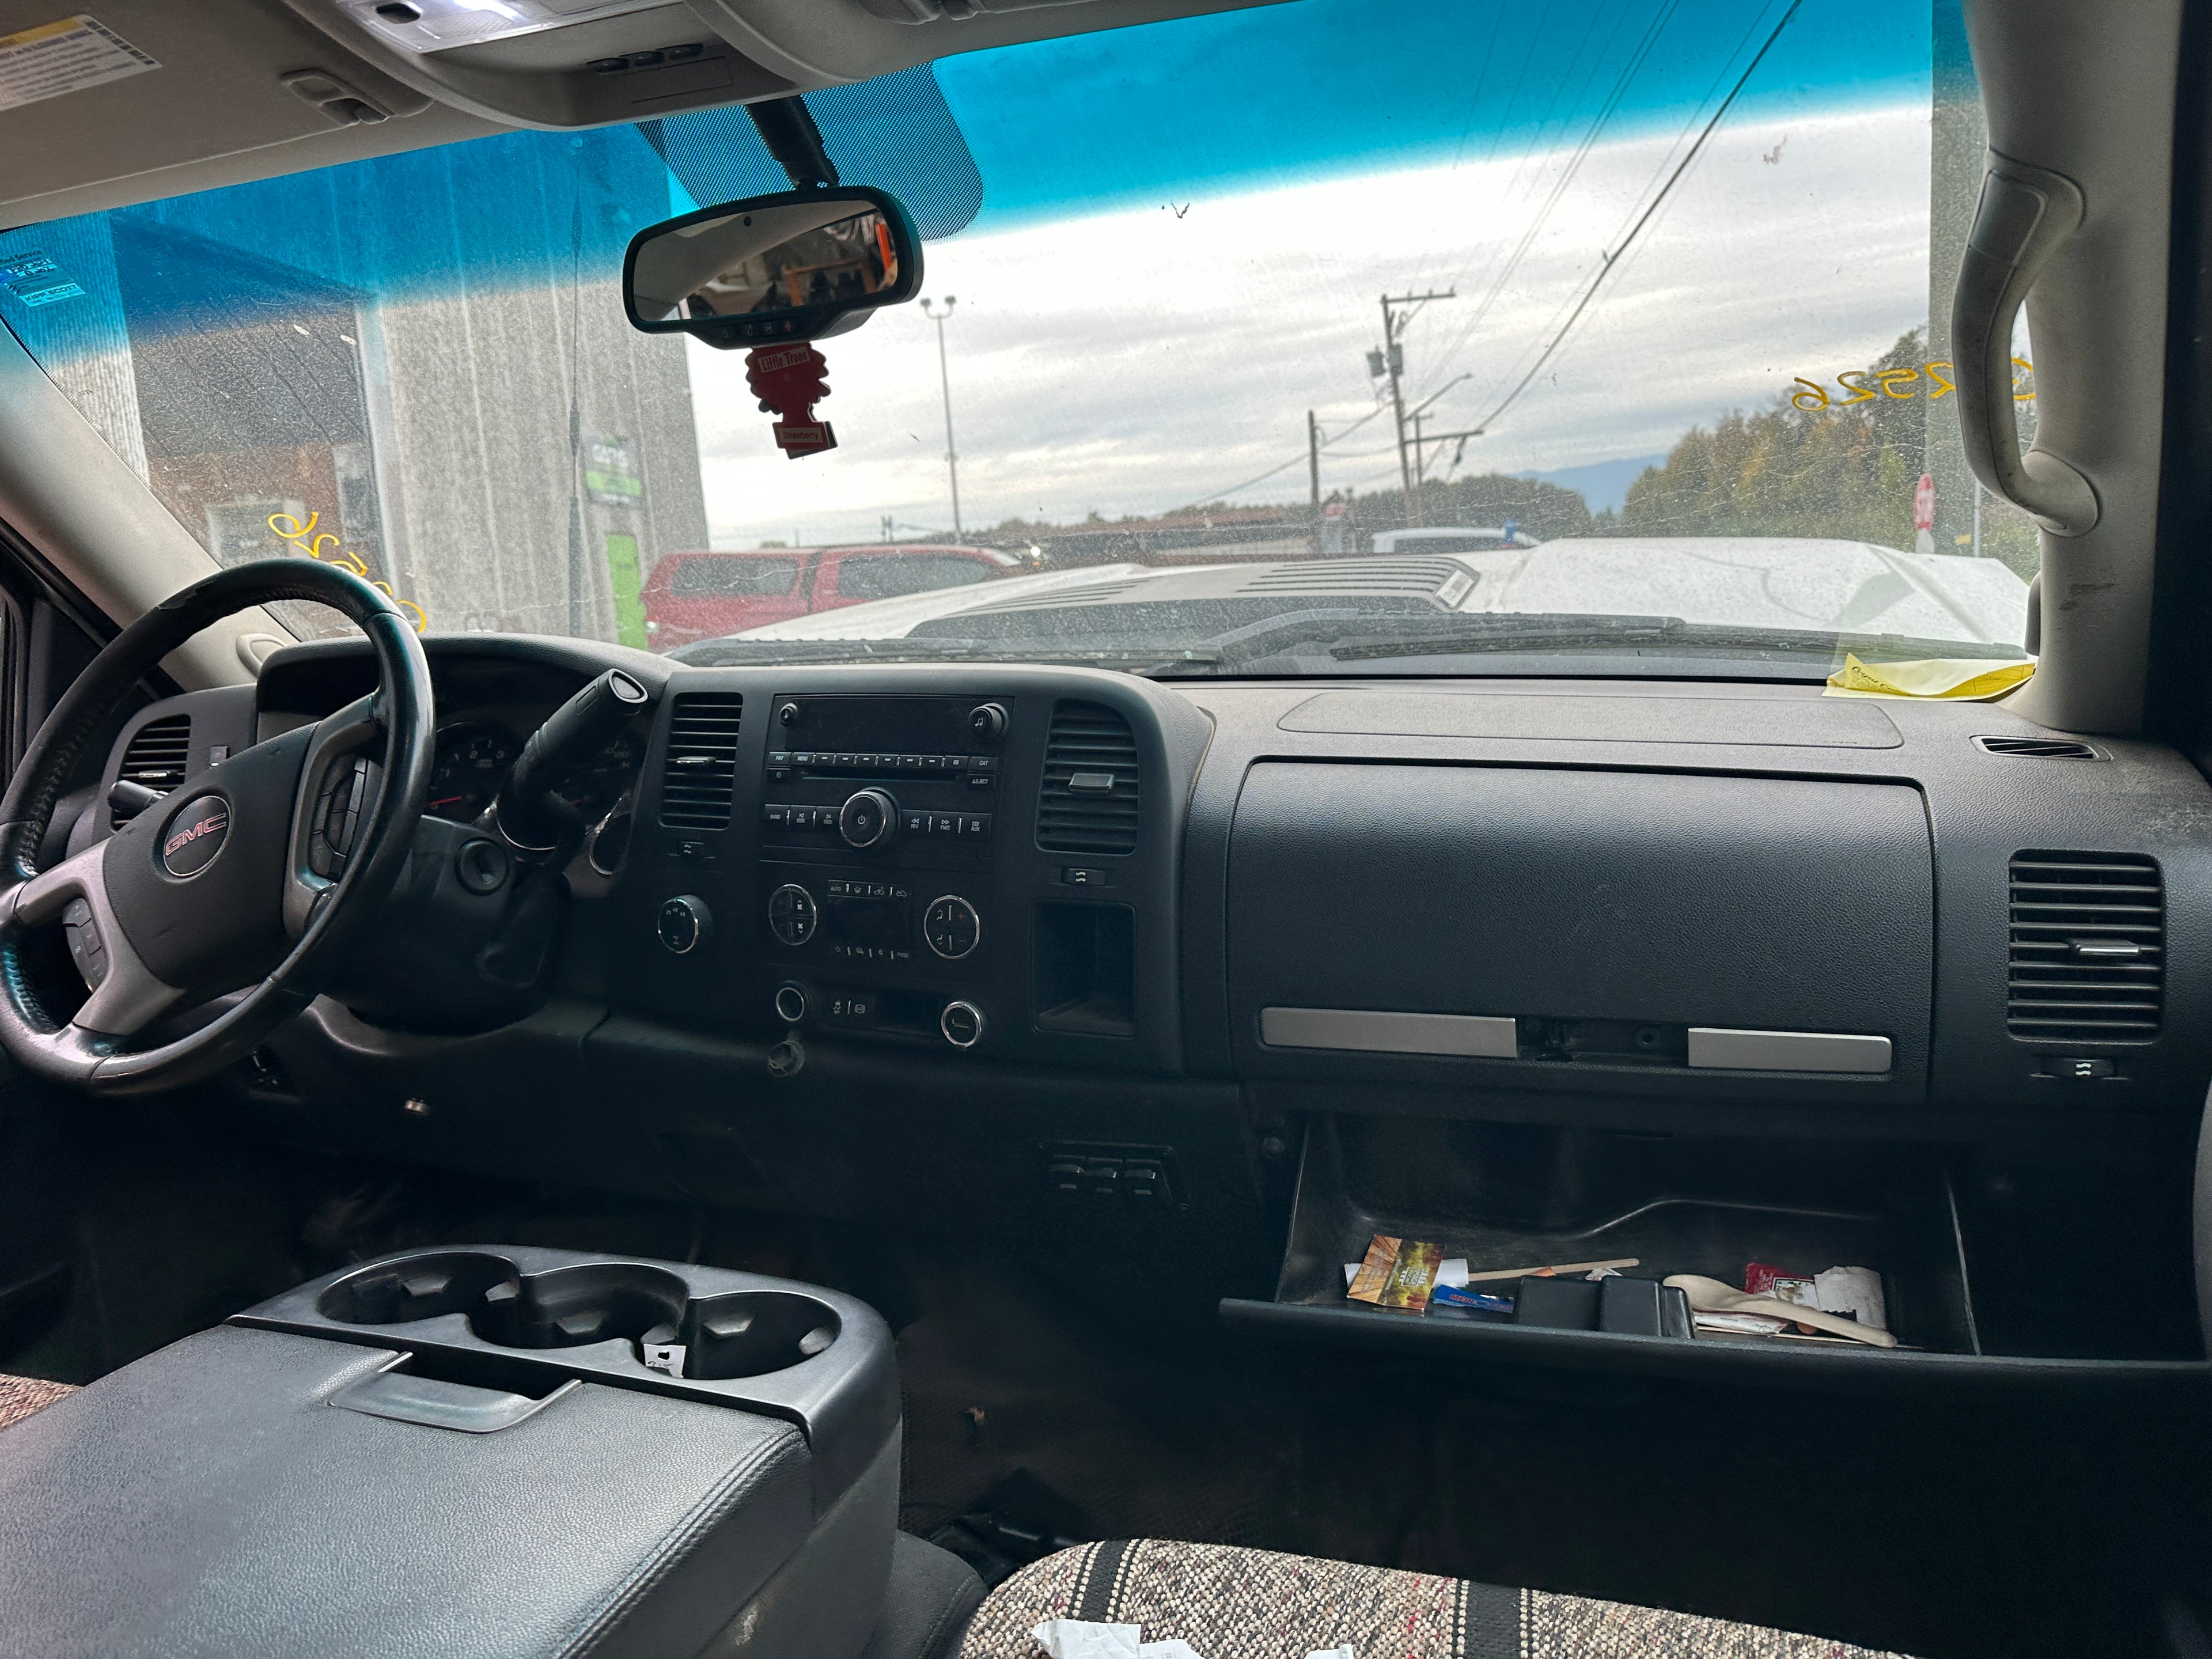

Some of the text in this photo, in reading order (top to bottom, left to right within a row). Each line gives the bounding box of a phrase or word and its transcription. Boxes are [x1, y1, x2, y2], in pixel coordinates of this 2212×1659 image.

[25, 292, 46, 301] KIPP
[47, 285, 77, 295] SCOTT
[762, 351, 807, 371] Little Trees
[783, 431, 818, 441] Strawberry
[166, 812, 227, 856] GMC
